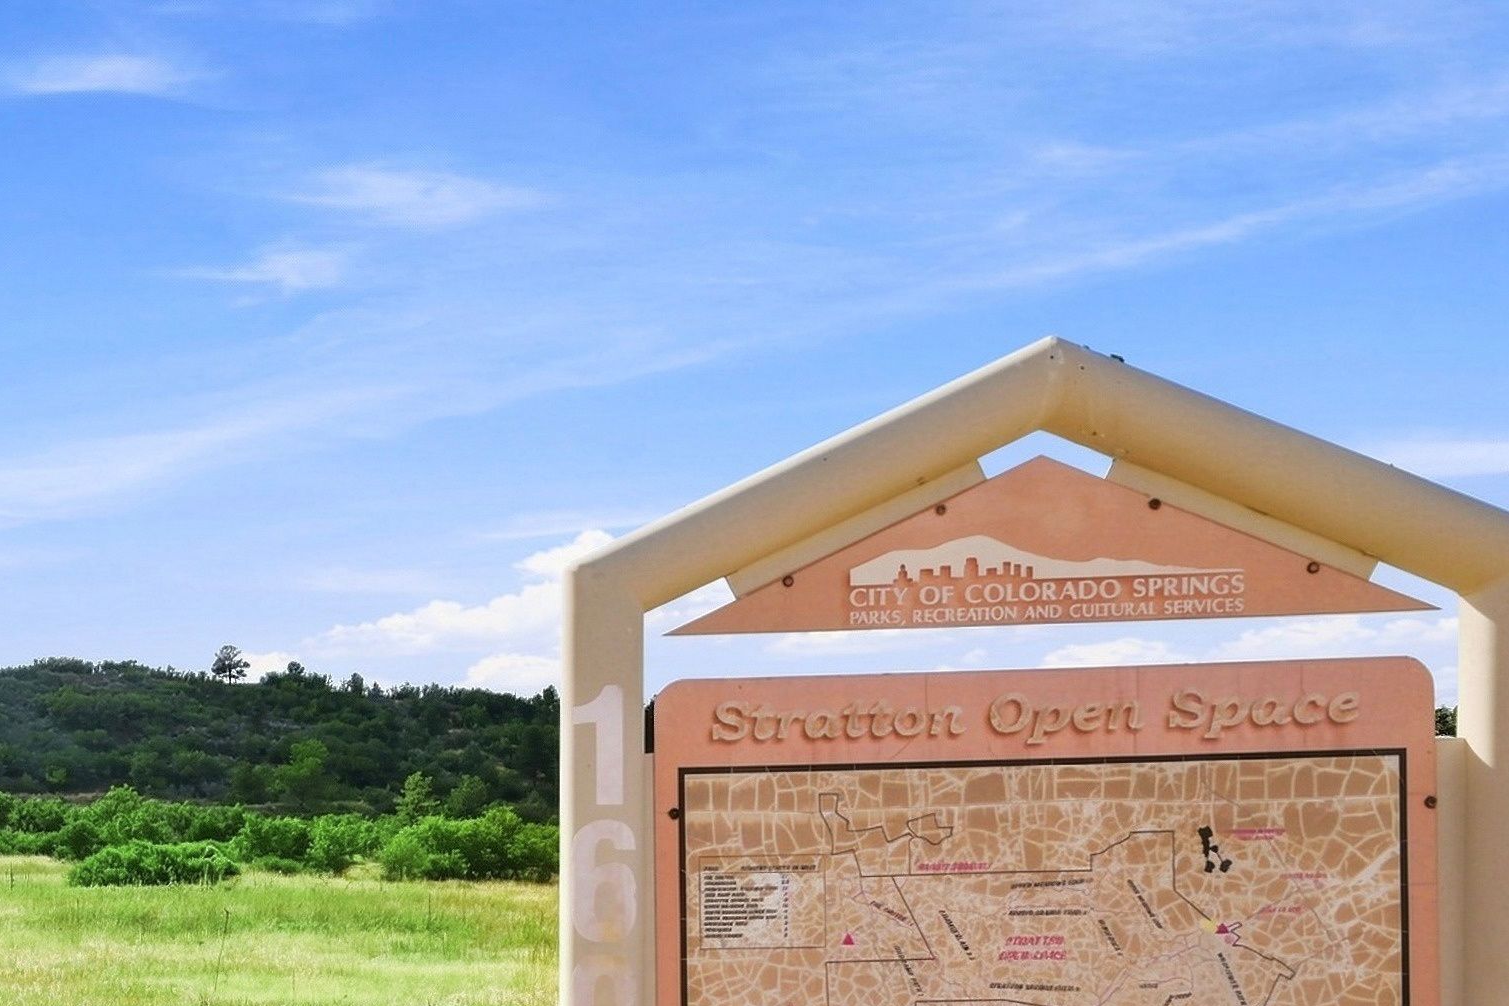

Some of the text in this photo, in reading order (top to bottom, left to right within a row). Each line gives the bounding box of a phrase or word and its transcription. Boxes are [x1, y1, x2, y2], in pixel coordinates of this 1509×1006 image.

[849, 574, 1245, 607] CITY OF COLORADO SPRINGS
[849, 598, 1245, 628] PARKS, RECREATION AND CULTURAL SERVICES
[711, 687, 1361, 745] Stratton Open Space
